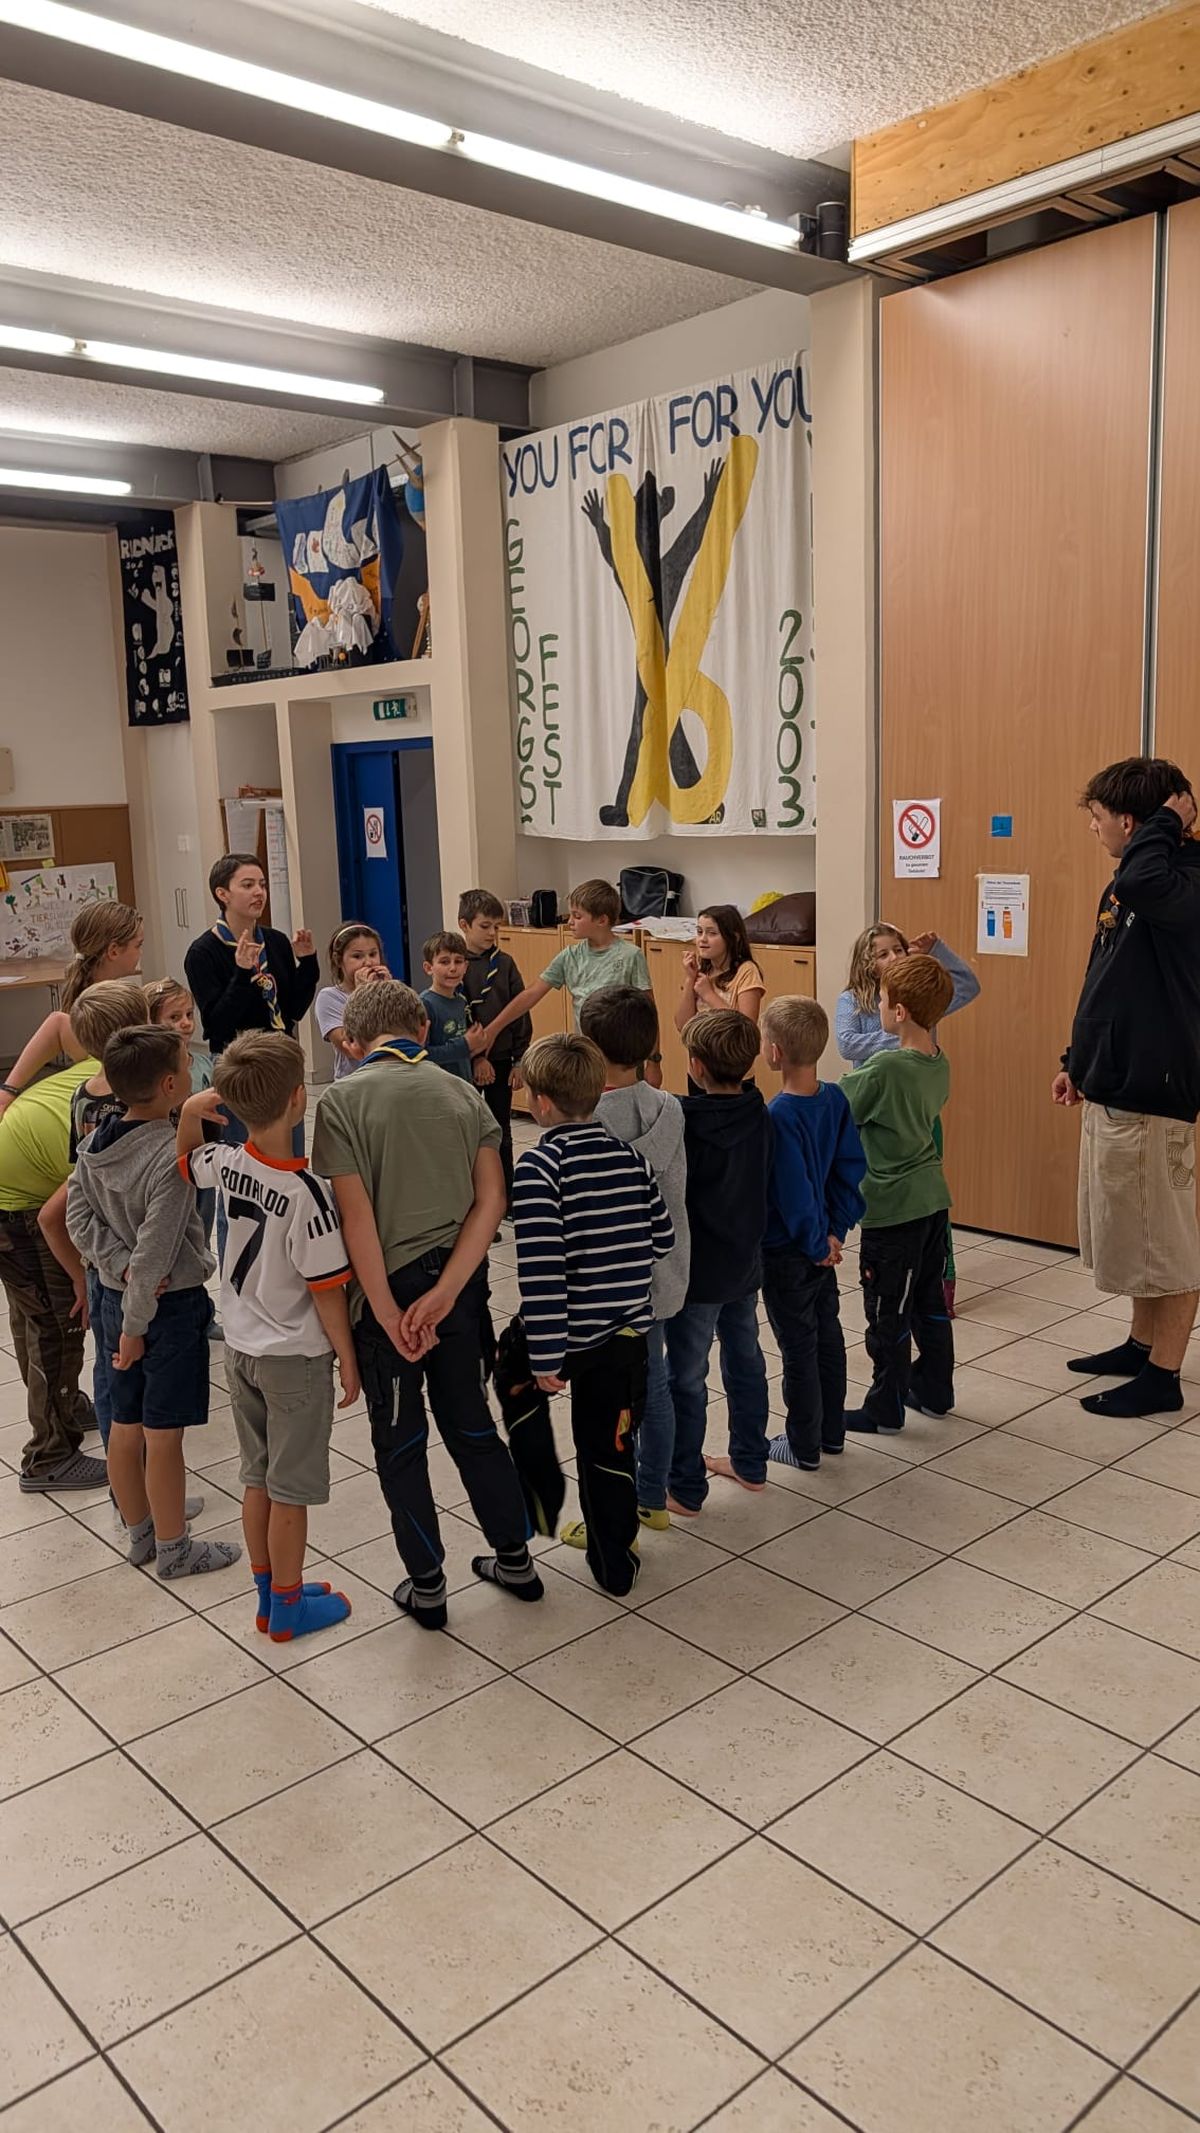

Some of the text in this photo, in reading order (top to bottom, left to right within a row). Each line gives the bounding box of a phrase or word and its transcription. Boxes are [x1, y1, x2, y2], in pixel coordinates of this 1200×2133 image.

[503, 435, 558, 497] YOU
[669, 385, 740, 454] FOR
[539, 633, 562, 826] FEST
[777, 609, 805, 828] 2003
[221, 1166, 290, 1218] RONALDO
[228, 1195, 268, 1297] 7
